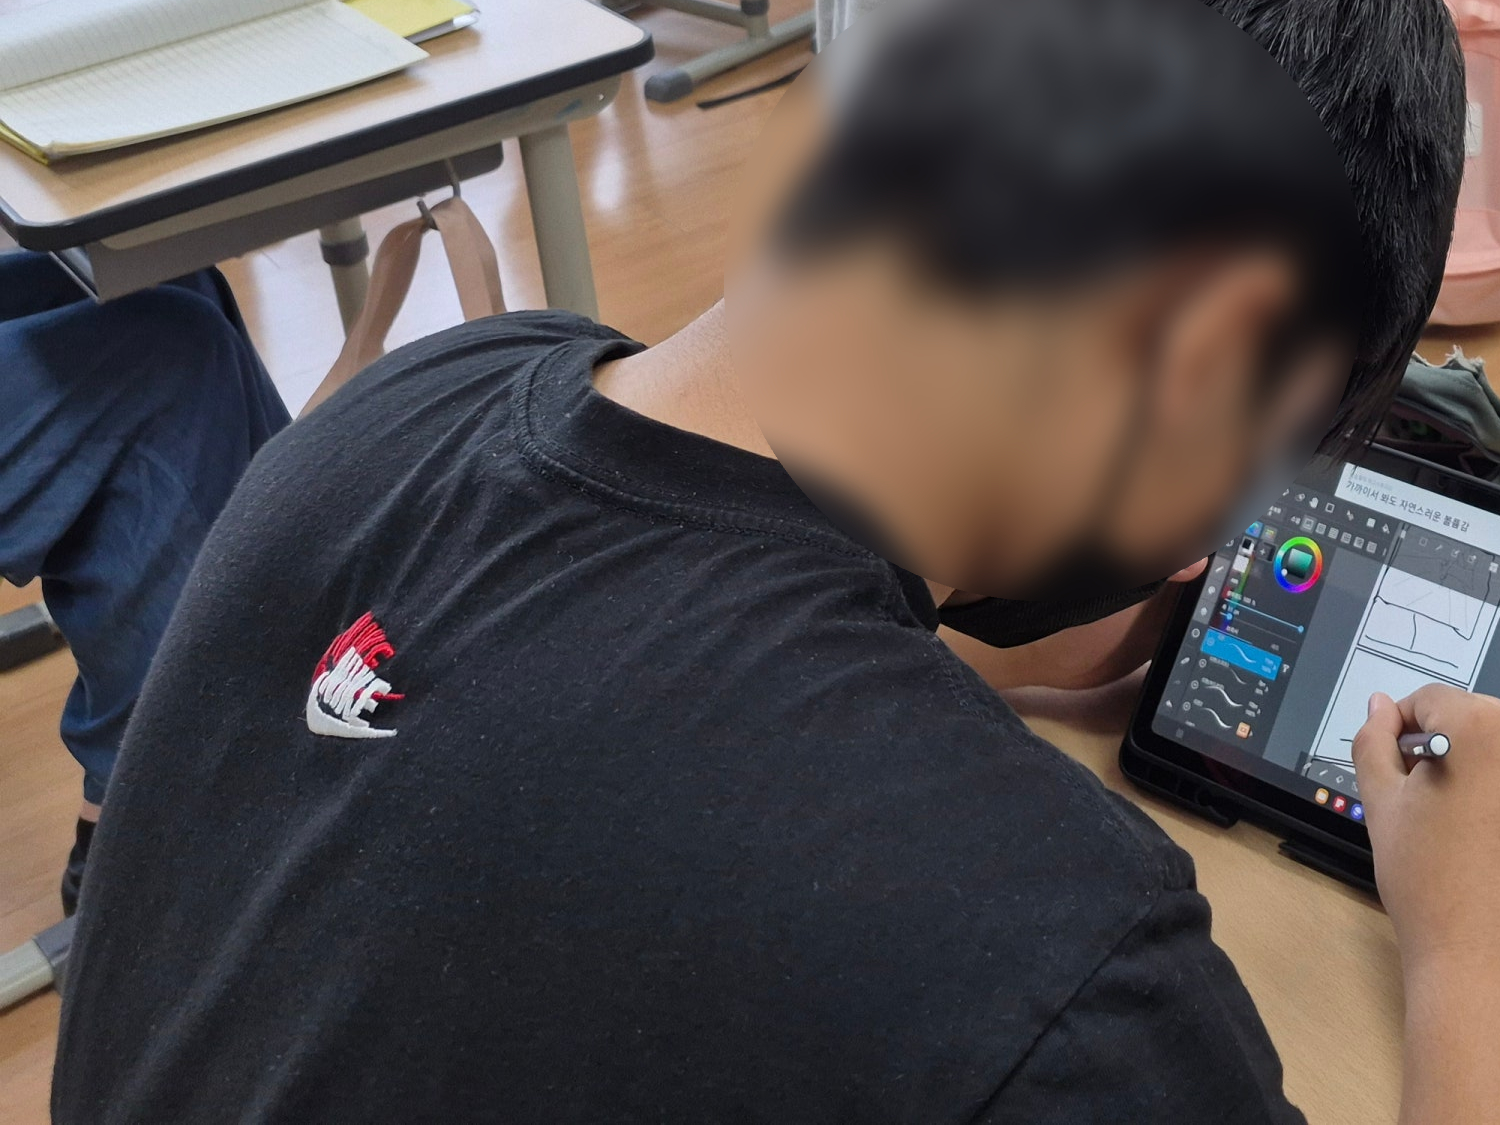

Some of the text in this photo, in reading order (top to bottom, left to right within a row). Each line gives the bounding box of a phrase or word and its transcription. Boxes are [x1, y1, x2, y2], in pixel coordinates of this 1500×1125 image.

[1345, 480, 1379, 500] 가까이서
[1380, 493, 1398, 507] 봐도
[1399, 499, 1442, 524] 자연스러운
